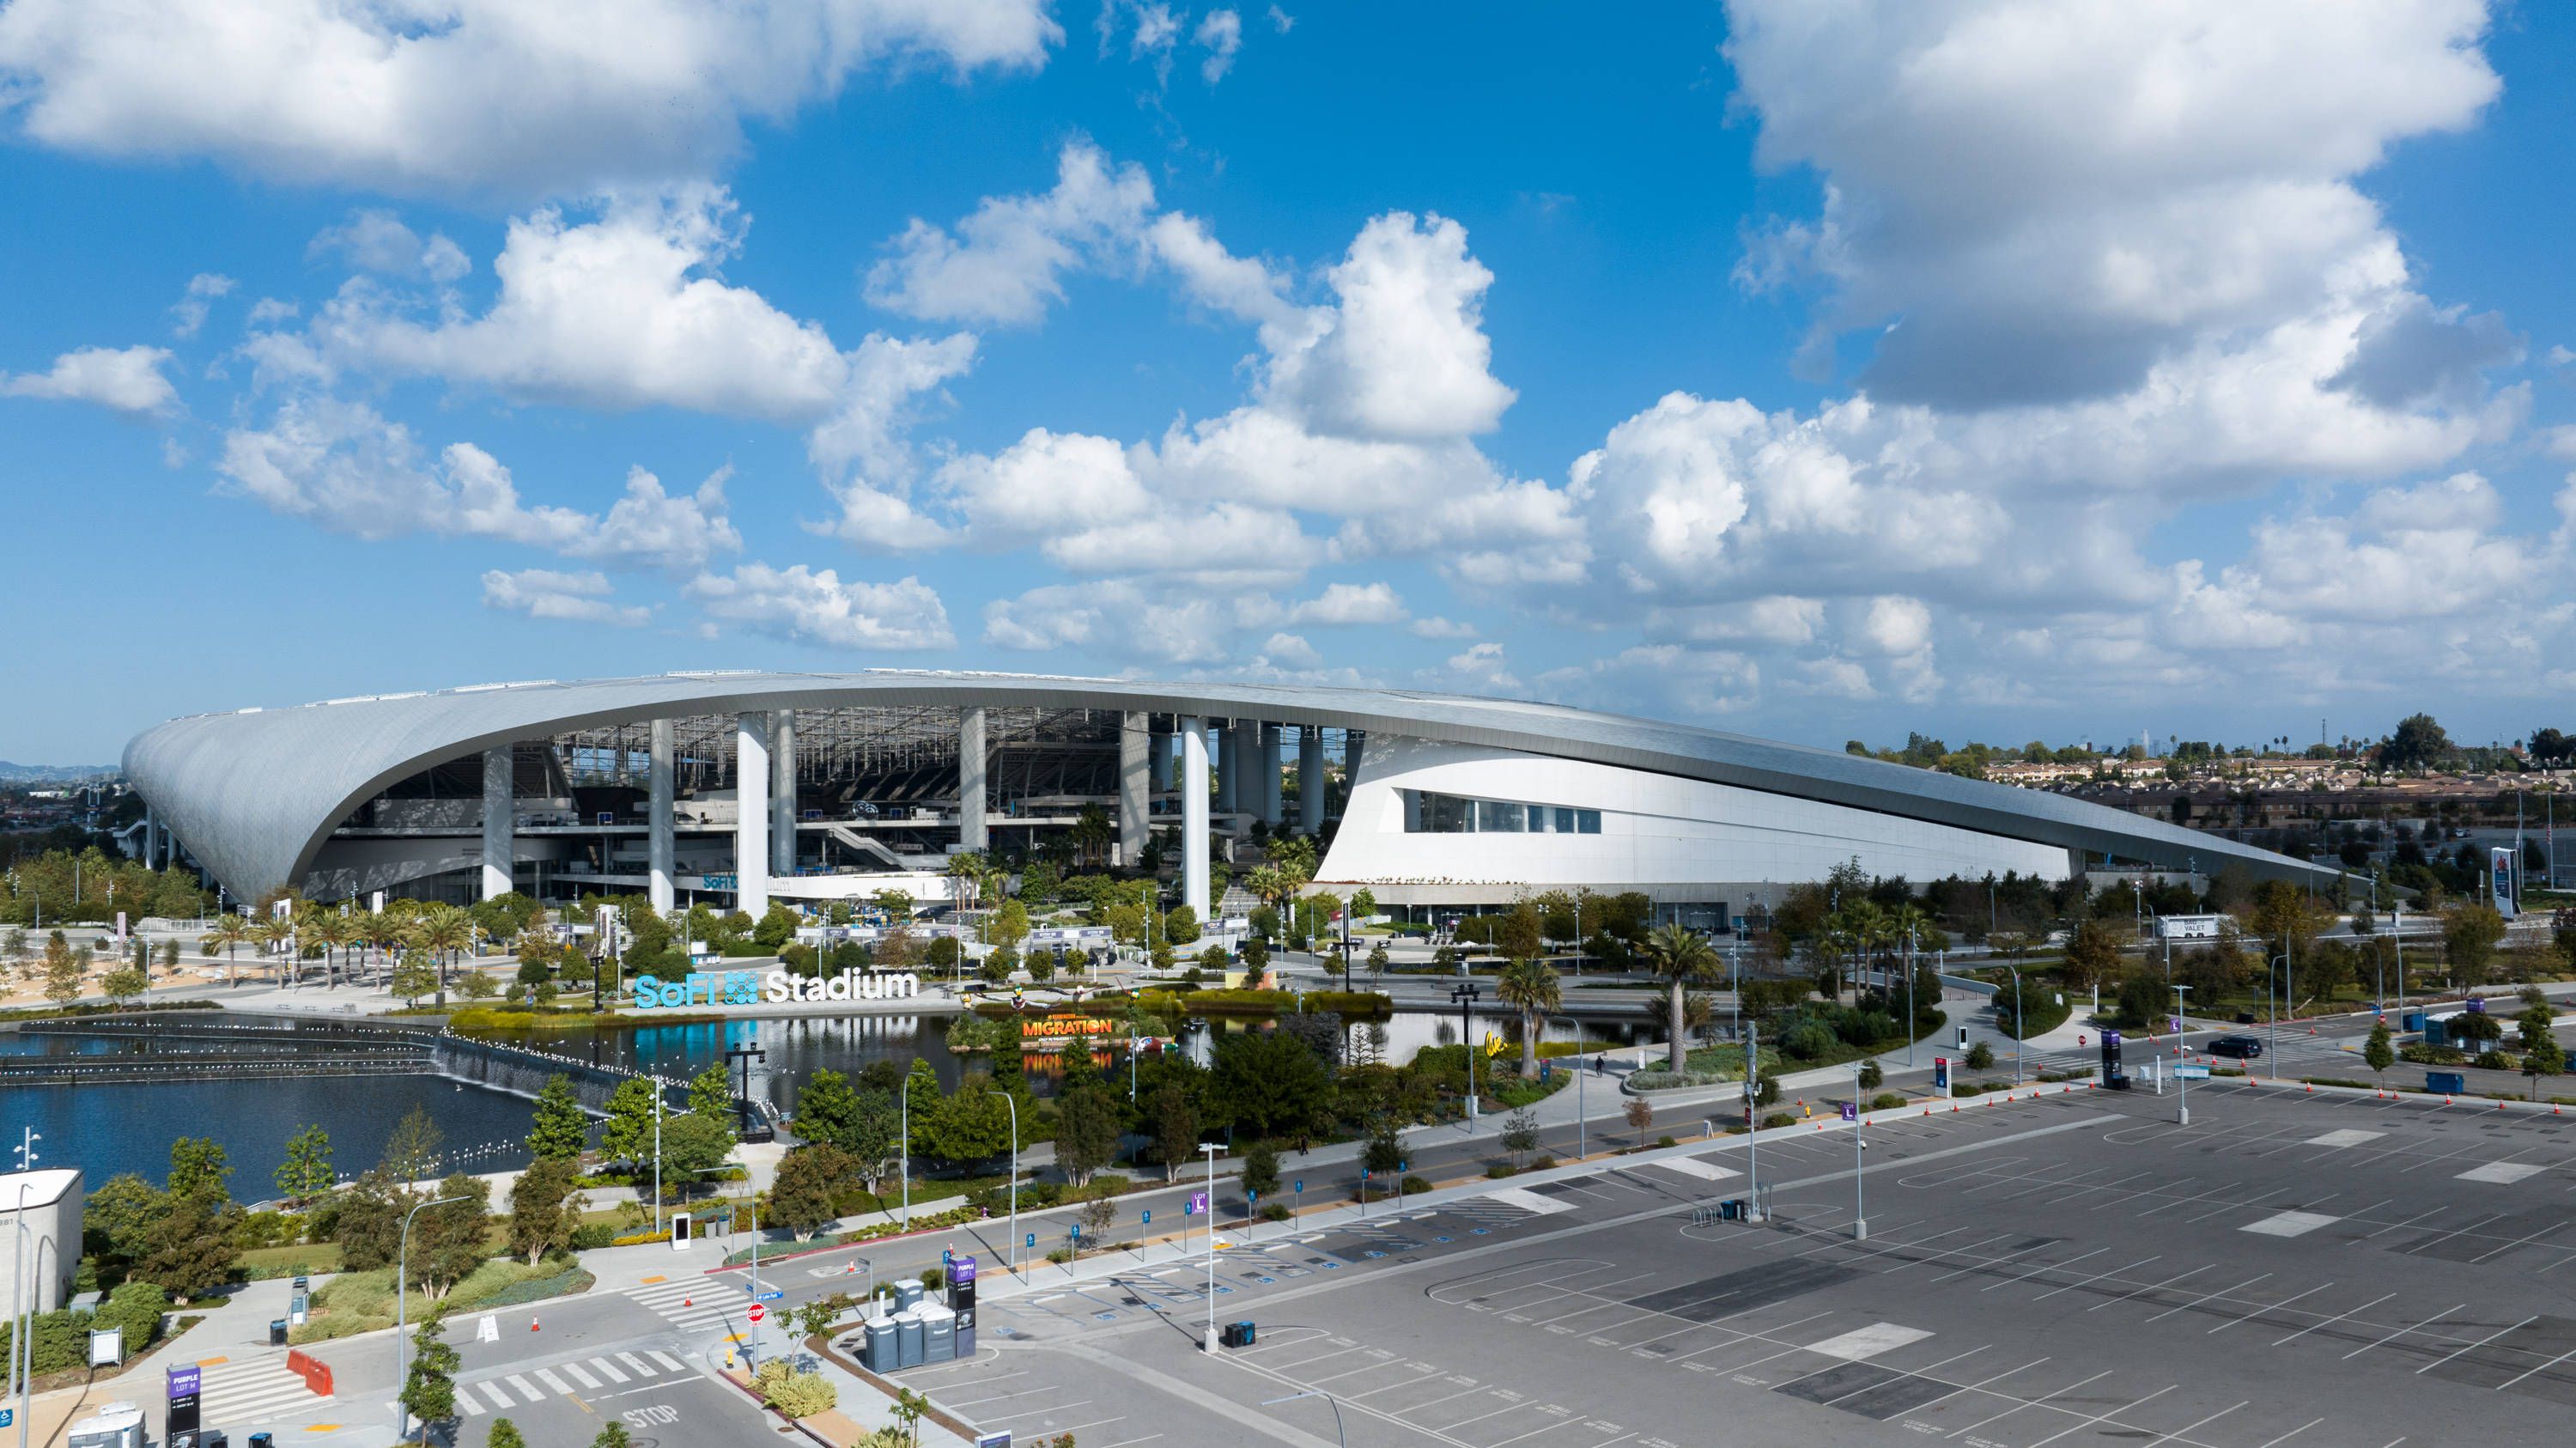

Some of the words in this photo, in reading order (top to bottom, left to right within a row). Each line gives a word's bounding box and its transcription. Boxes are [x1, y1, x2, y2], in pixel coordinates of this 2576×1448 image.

[703, 873, 729, 889] SoFi
[635, 974, 715, 1008] SoFi
[766, 967, 918, 1003] Stadium
[1023, 1019, 1112, 1036] MIGRATION
[1197, 1199, 1204, 1209] L
[749, 1309, 764, 1317] STOP
[173, 1374, 198, 1384] PURPLE
[622, 1405, 679, 1427] STOP
